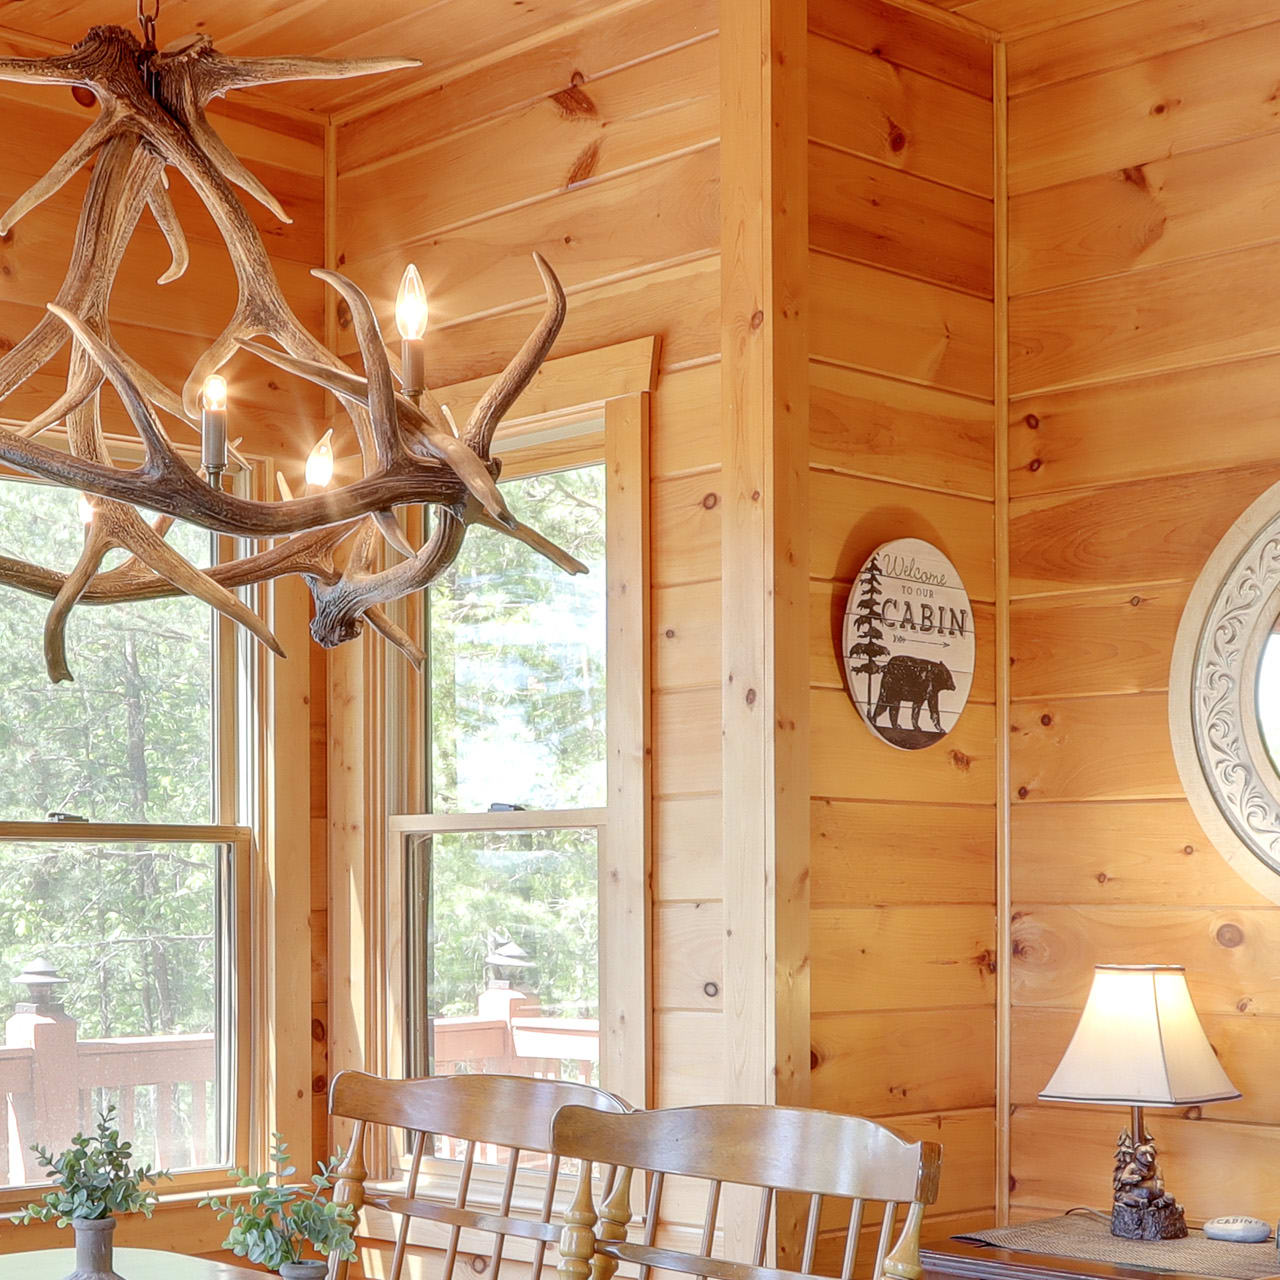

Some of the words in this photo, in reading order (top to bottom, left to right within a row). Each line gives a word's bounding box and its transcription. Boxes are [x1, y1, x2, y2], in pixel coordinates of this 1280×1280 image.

[883, 554, 947, 586] Welcome
[901, 585, 913, 596] TO
[916, 587, 935, 599] OUR
[881, 598, 968, 637] CABIN
